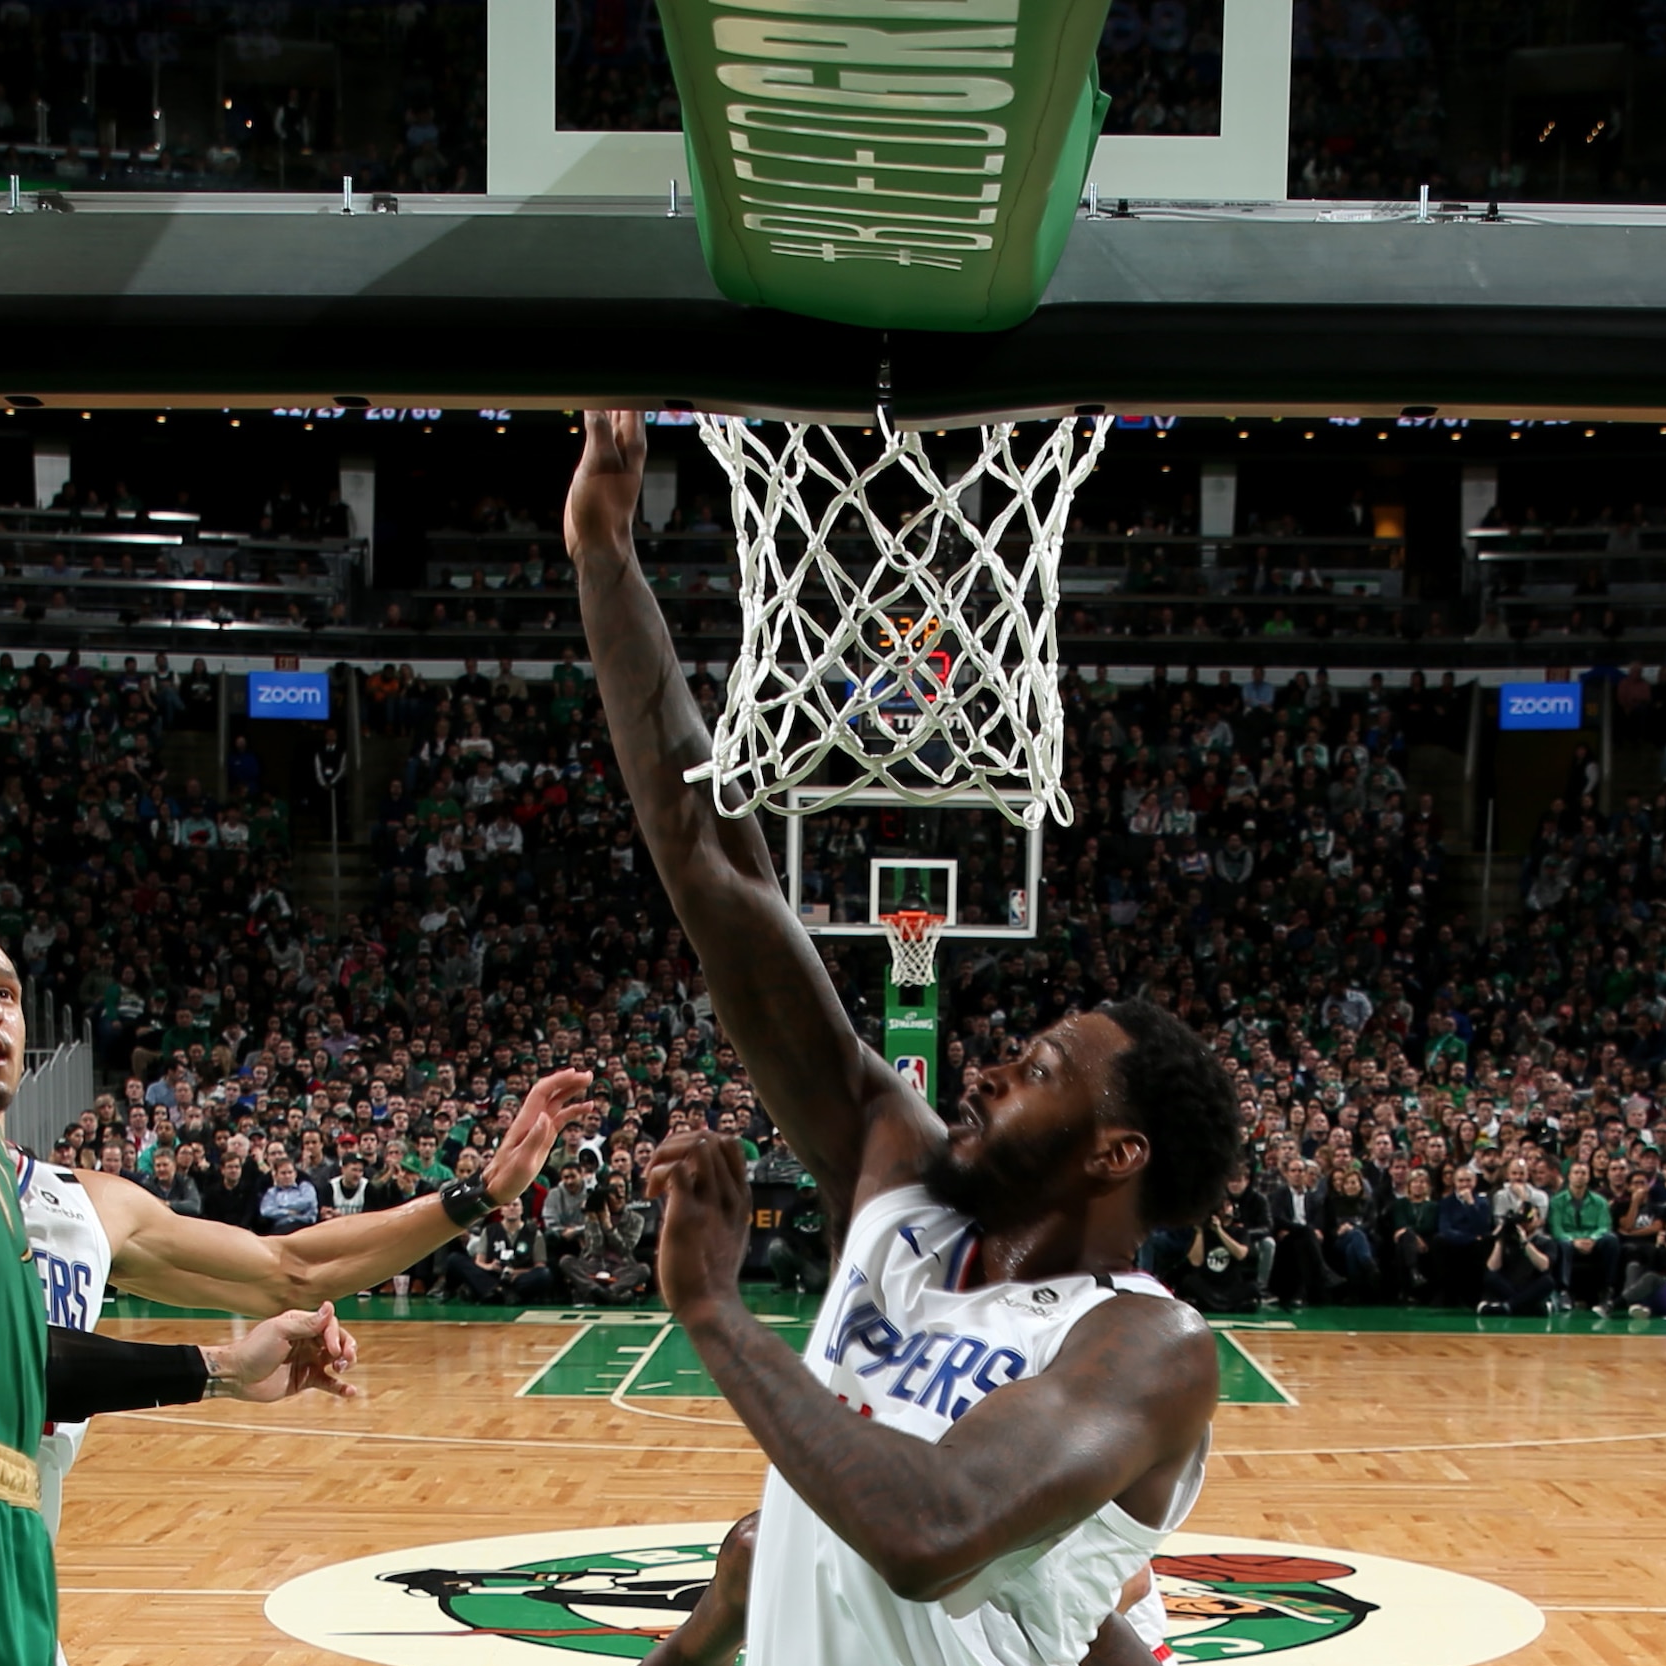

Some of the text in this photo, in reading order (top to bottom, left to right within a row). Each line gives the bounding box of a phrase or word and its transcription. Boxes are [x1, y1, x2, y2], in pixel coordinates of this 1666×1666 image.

[708, 0, 1021, 270] #BLEEDGR
[256, 685, 321, 704] zoom
[1508, 694, 1573, 715] zoom
